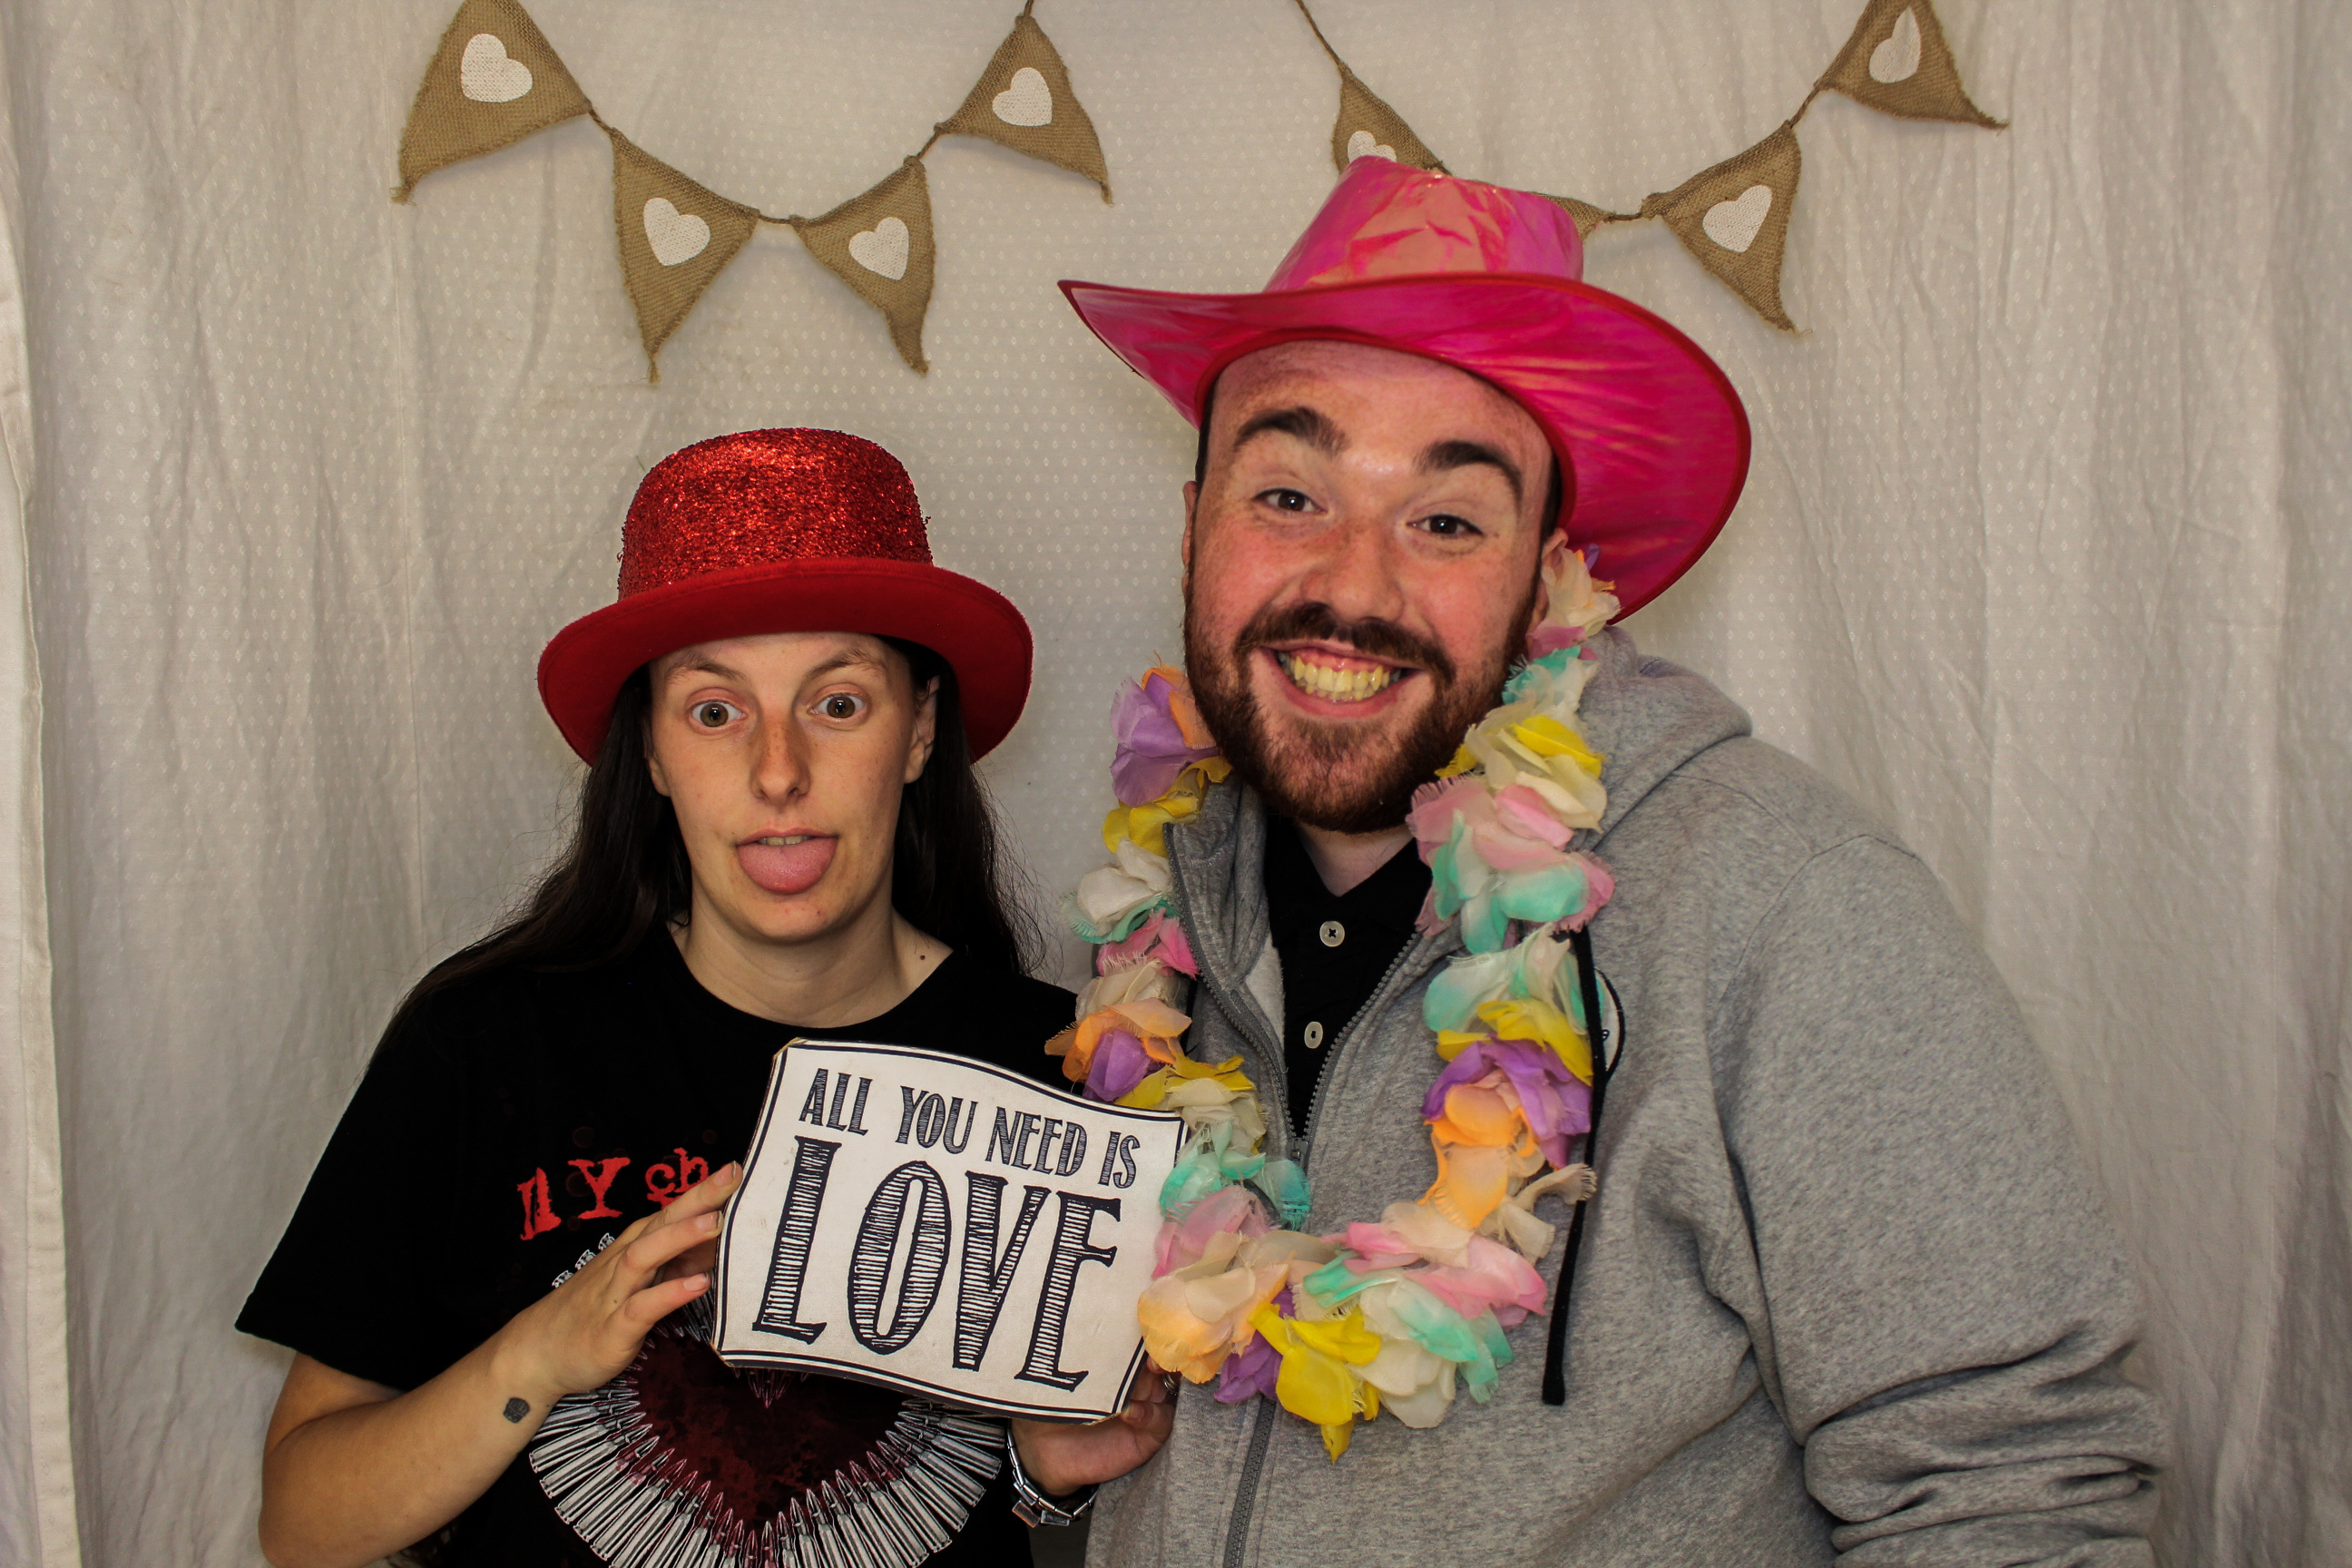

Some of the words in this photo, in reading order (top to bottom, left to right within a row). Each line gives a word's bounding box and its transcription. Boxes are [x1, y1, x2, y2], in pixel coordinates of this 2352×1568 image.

[799, 1068, 872, 1135] ALL
[896, 1086, 978, 1154] YOU
[985, 1106, 1087, 1176] NEED
[1098, 1132, 1140, 1189] IS
[752, 1135, 1121, 1392] LOVE
